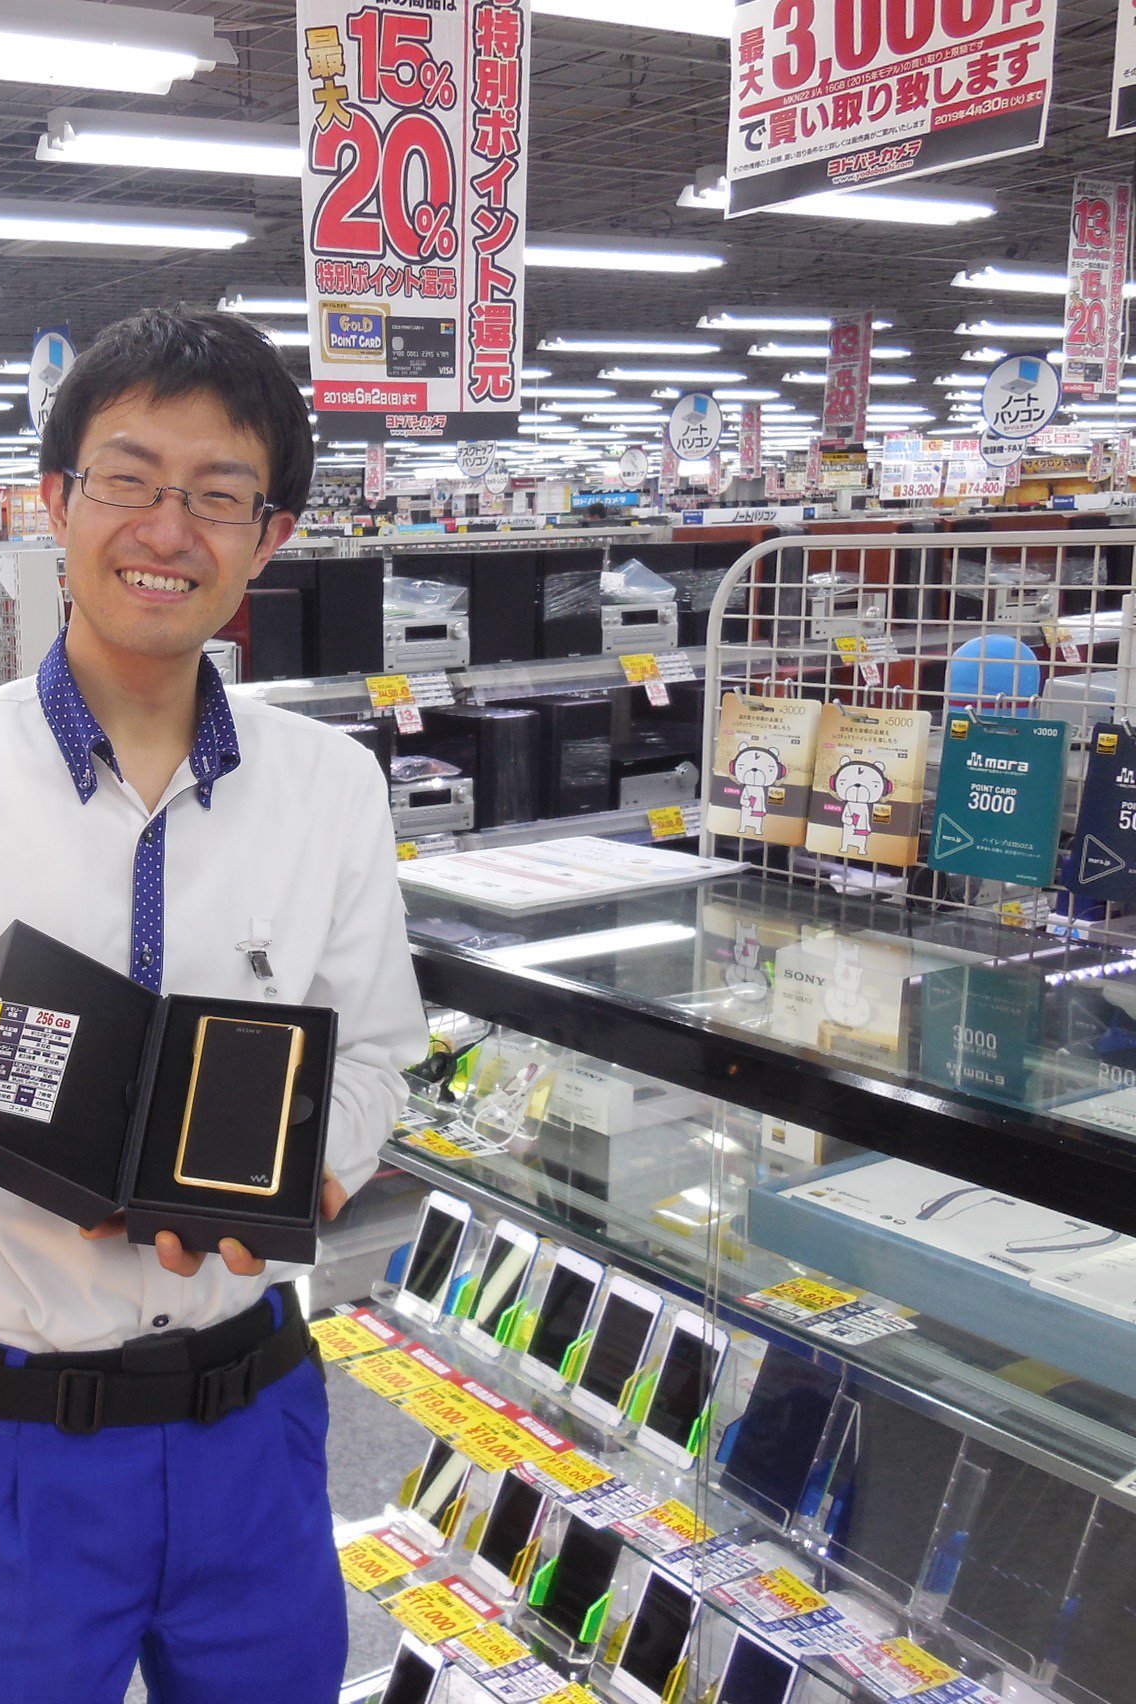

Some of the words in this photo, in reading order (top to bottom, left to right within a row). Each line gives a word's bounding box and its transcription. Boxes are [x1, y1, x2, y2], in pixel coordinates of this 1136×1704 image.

[347, 6, 457, 110] 15%
[738, 27, 765, 101] 最大
[305, 25, 354, 132] 最大
[739, 42, 1041, 151] で買い取り致します
[827, 140, 922, 177] ヨドバシカメラ
[310, 105, 456, 265] 20%
[471, 0, 524, 404] 特別ポイント還元
[316, 260, 457, 299] 特別ポイント還元
[358, 335, 382, 350] CARD
[439, 366, 454, 375] VISA
[1001, 393, 1039, 409] ノート
[385, 414, 448, 428] ヨドバシカメラ
[994, 409, 1045, 424] パソコン
[682, 424, 708, 436] ノート
[677, 437, 712, 449] パソコン
[732, 511, 777, 522] ノートパソコン
[985, 757, 1029, 773] mora
[971, 783, 993, 793] POINT
[995, 786, 1017, 796] CARD
[968, 792, 1015, 815] 3000
[783, 969, 825, 987] SONY
[36, 1011, 54, 1026] 256
[55, 1019, 71, 1029] GB
[9, 1103, 30, 1113] ゴールド
[311, 1322, 358, 1354] ¥19,000
[363, 1354, 413, 1390] ¥19,000
[415, 1388, 469, 1425] ¥19,000
[466, 1424, 524, 1464] ¥19,000
[403, 1590, 456, 1632] ¥17,000
